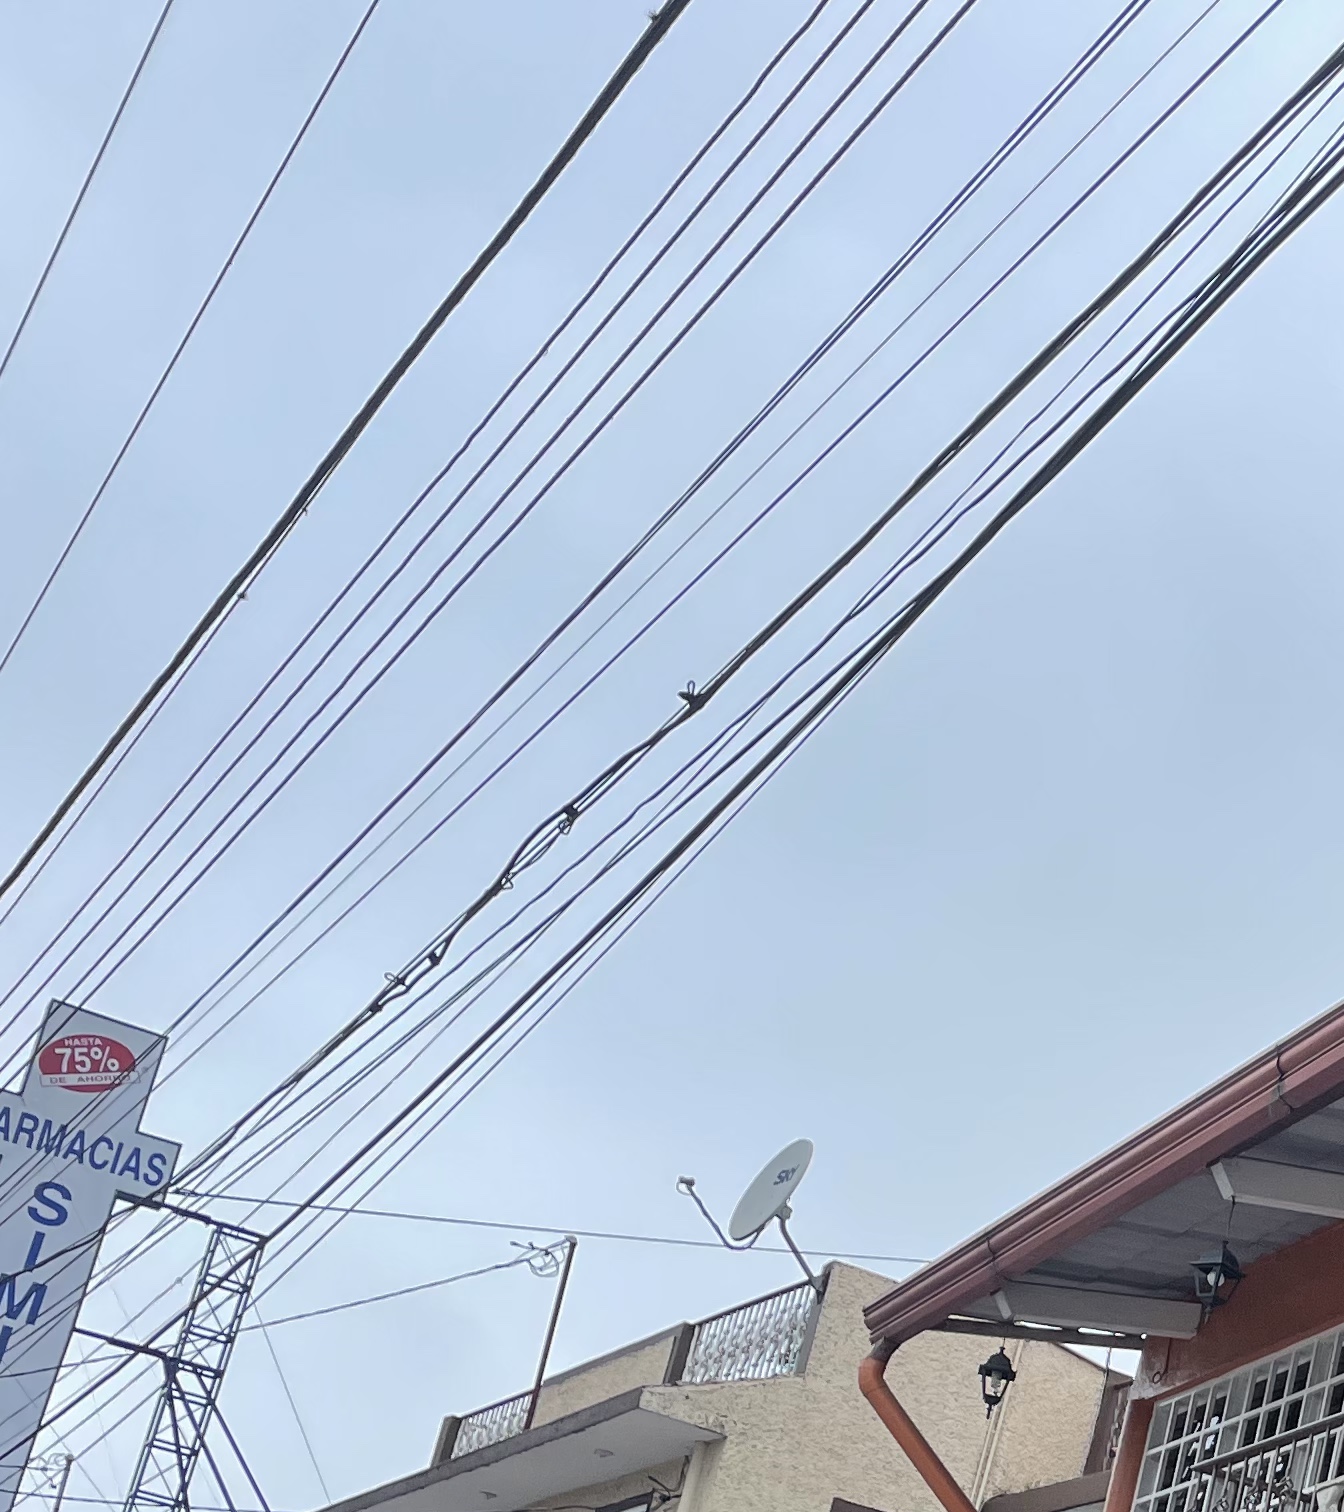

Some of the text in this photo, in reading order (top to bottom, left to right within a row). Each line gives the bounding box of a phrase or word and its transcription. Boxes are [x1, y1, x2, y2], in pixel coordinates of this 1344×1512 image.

[64, 1037, 103, 1047] HASTA
[54, 1045, 120, 1073] 75%
[49, 1076, 67, 1084] DE
[773, 1164, 800, 1185] SKY
